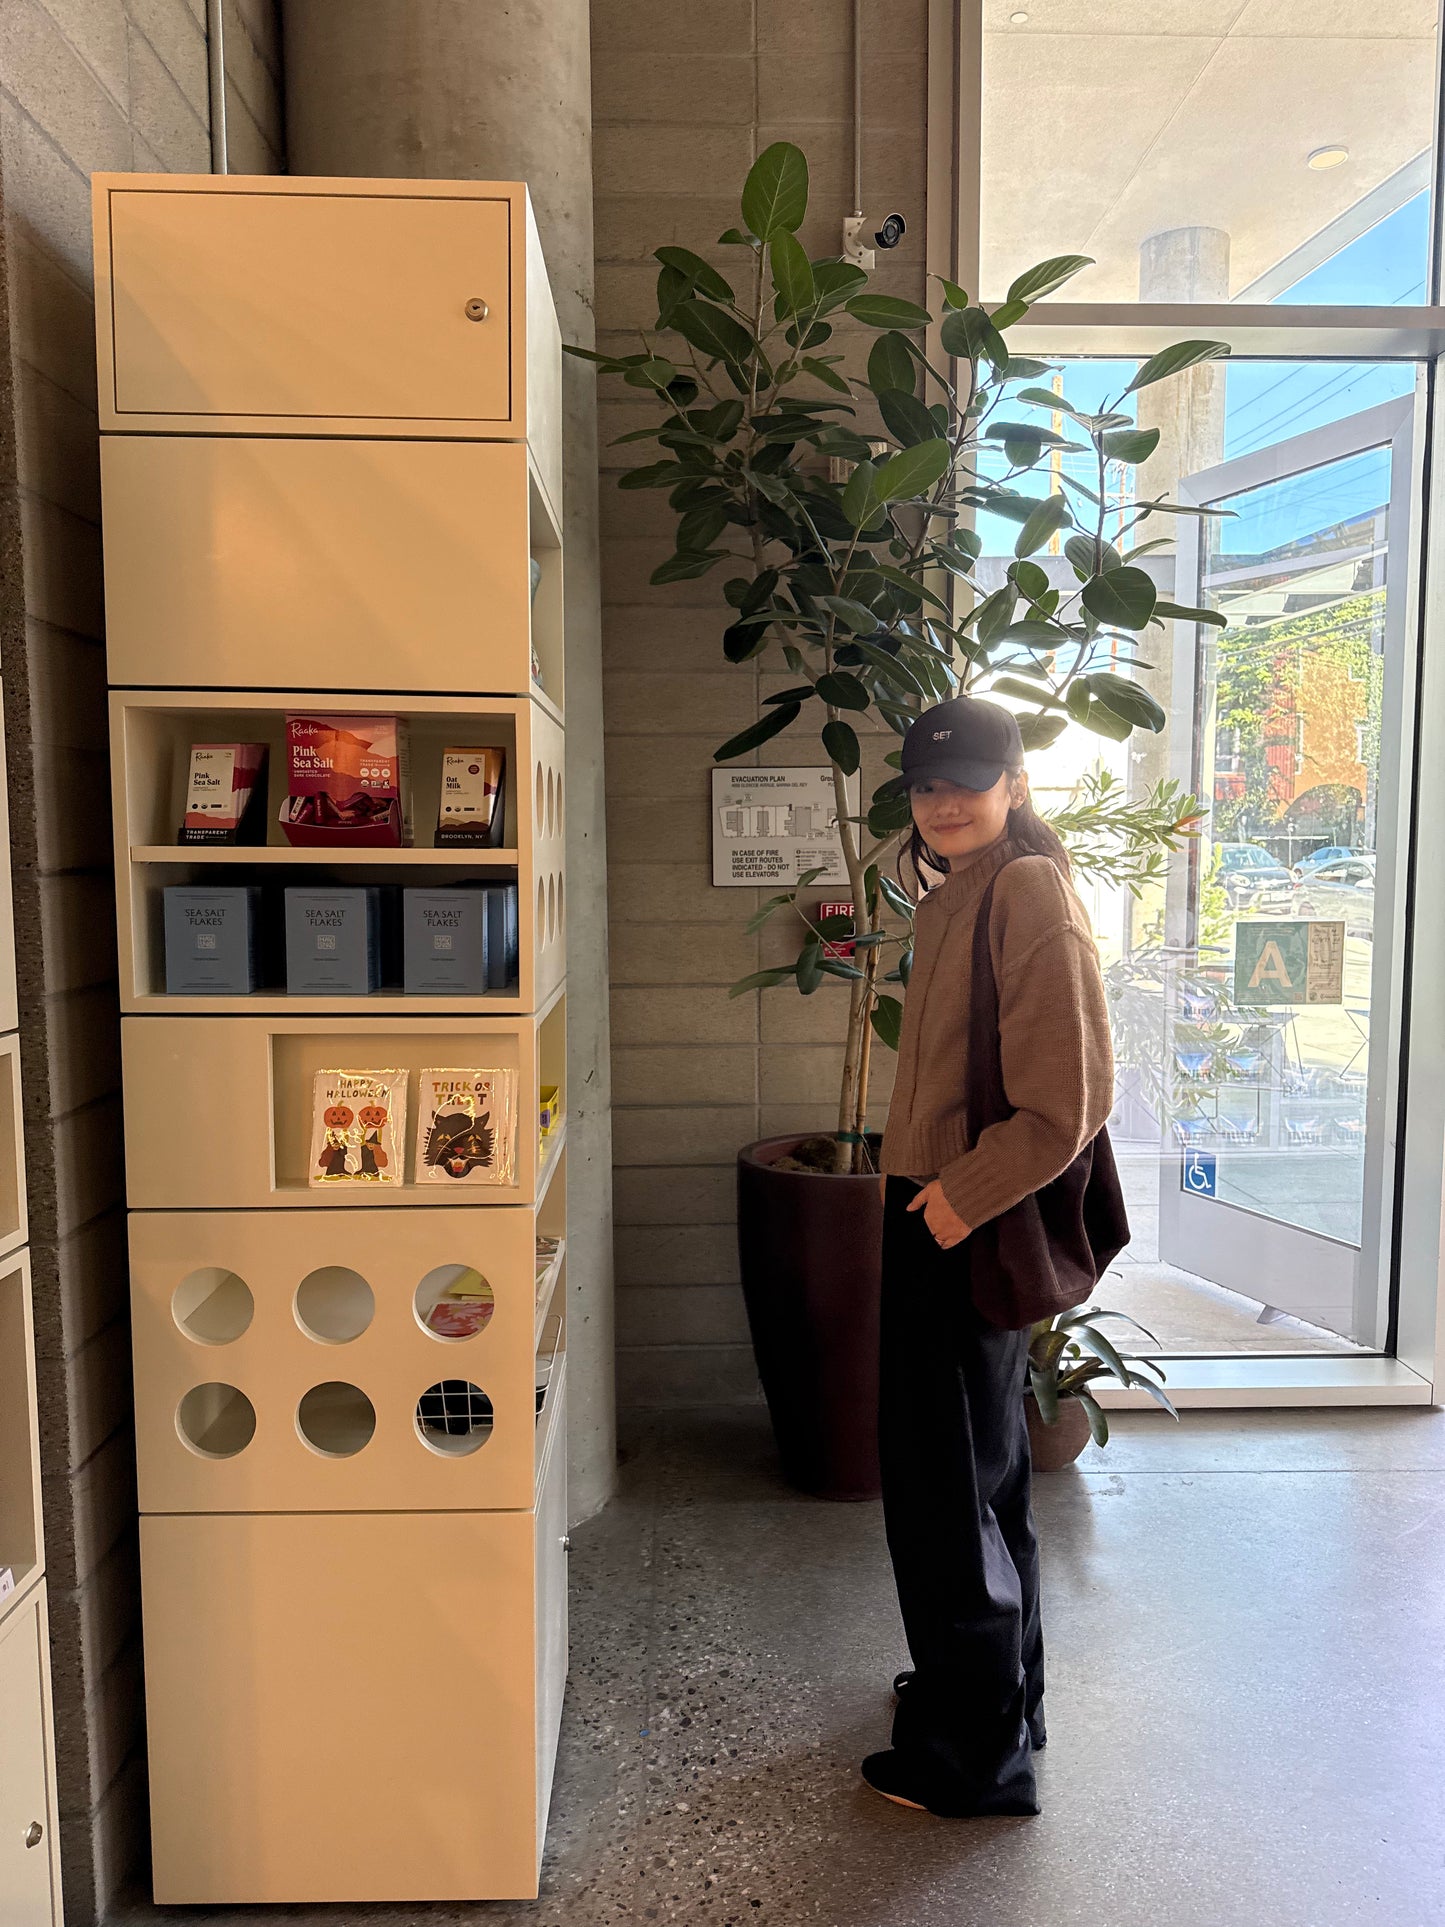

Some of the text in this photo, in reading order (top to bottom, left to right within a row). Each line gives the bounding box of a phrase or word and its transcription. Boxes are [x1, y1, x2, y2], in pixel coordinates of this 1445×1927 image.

[291, 722, 319, 738] Raaka
[932, 730, 952, 741] SET
[293, 745, 317, 757] Pink
[293, 757, 334, 769] Sea Salt
[194, 772, 210, 780] Pink
[185, 908, 226, 917] SEA SALT
[305, 909, 346, 918] SEA SALT
[423, 910, 463, 919] SEA SALT
[189, 917, 223, 926] FLAKES
[310, 918, 343, 927] FLAKES
[427, 919, 459, 927] FLAKES
[1247, 940, 1293, 988] A
[340, 1080, 374, 1089] HAPPY
[432, 1081, 472, 1092] TRICK
